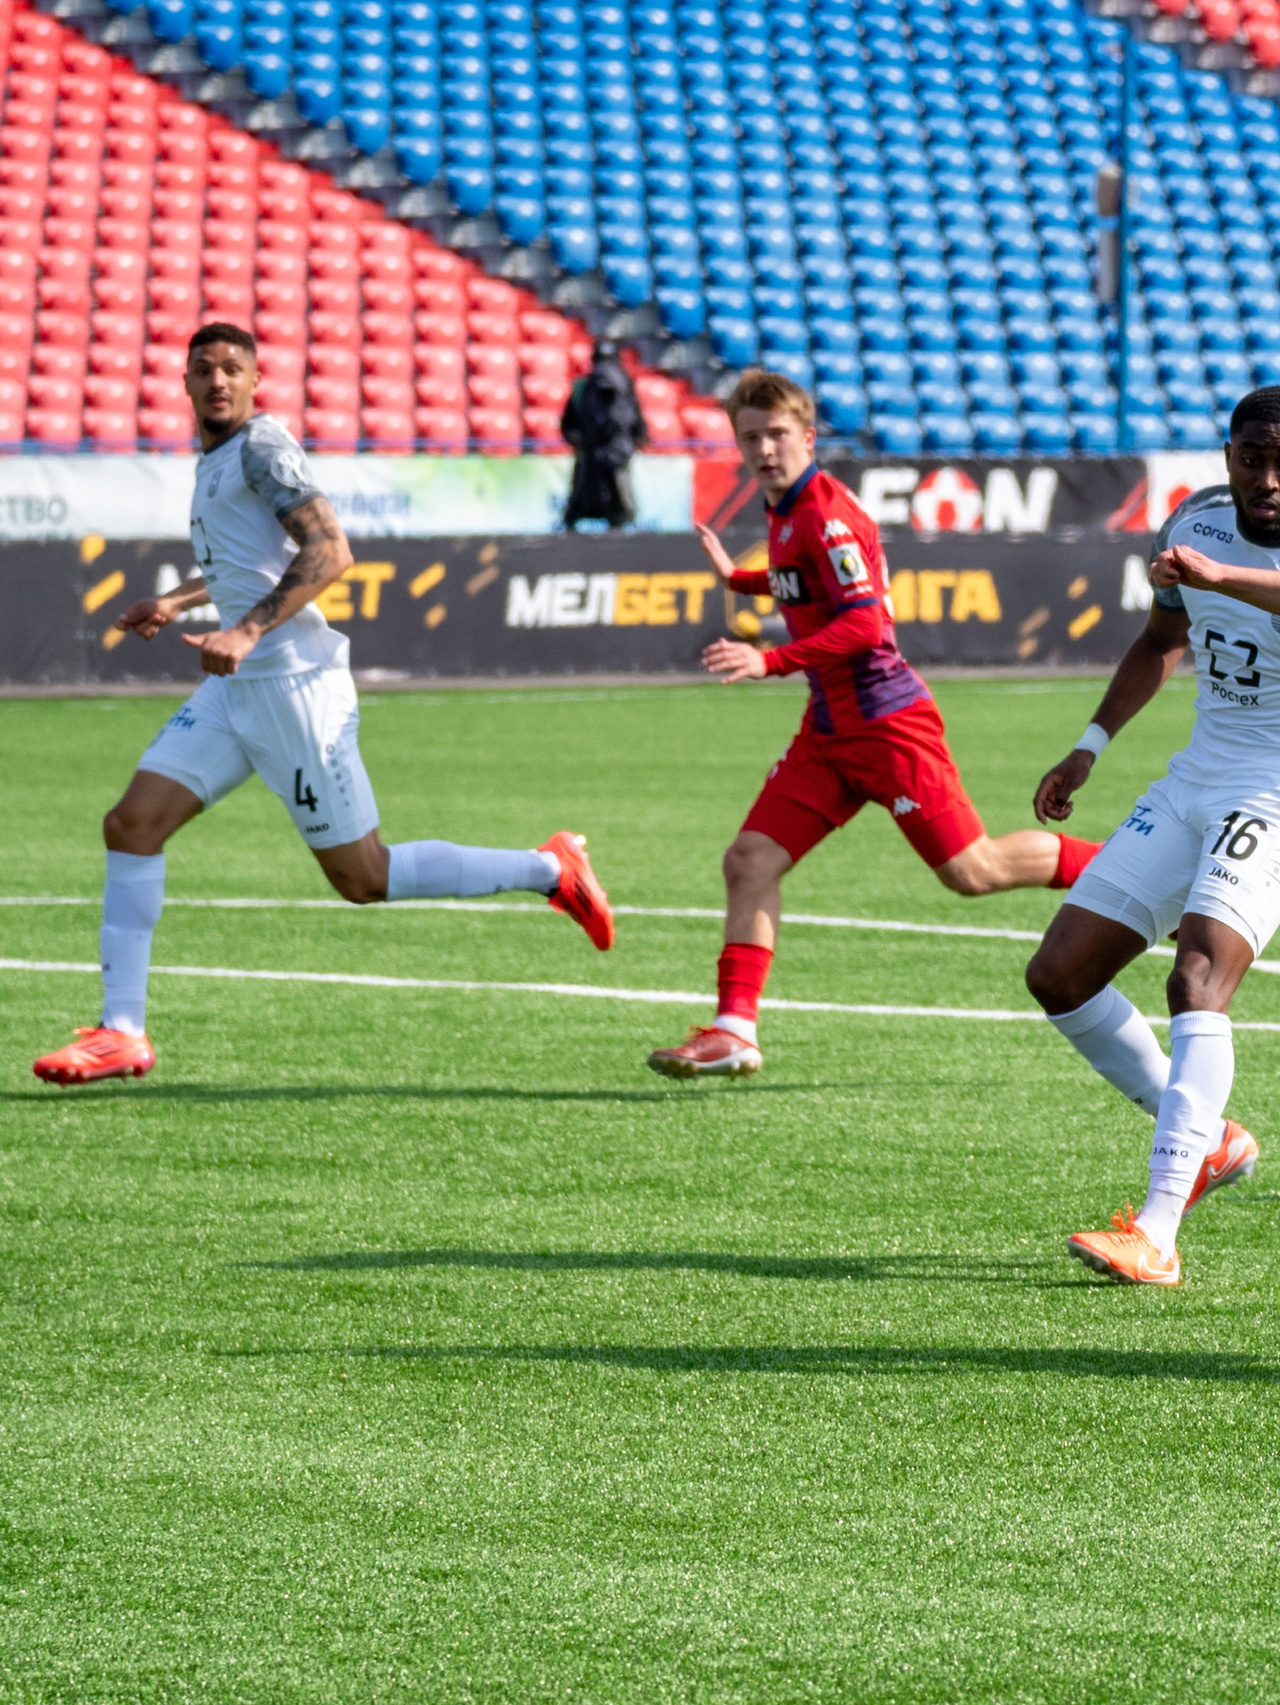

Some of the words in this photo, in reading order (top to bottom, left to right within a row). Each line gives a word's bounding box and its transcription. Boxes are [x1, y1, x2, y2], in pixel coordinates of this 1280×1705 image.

[1193, 522, 1234, 544] согаз
[505, 572, 717, 628] МЕЛБЕТ
[888, 568, 1002, 623] ИГА
[1210, 681, 1260, 707] Ростех
[294, 767, 319, 813] 4
[1125, 817, 1155, 836] ТИ
[1210, 810, 1267, 861] 16
[1208, 866, 1239, 886] JAKO
[1153, 1146, 1189, 1158] JAKO
